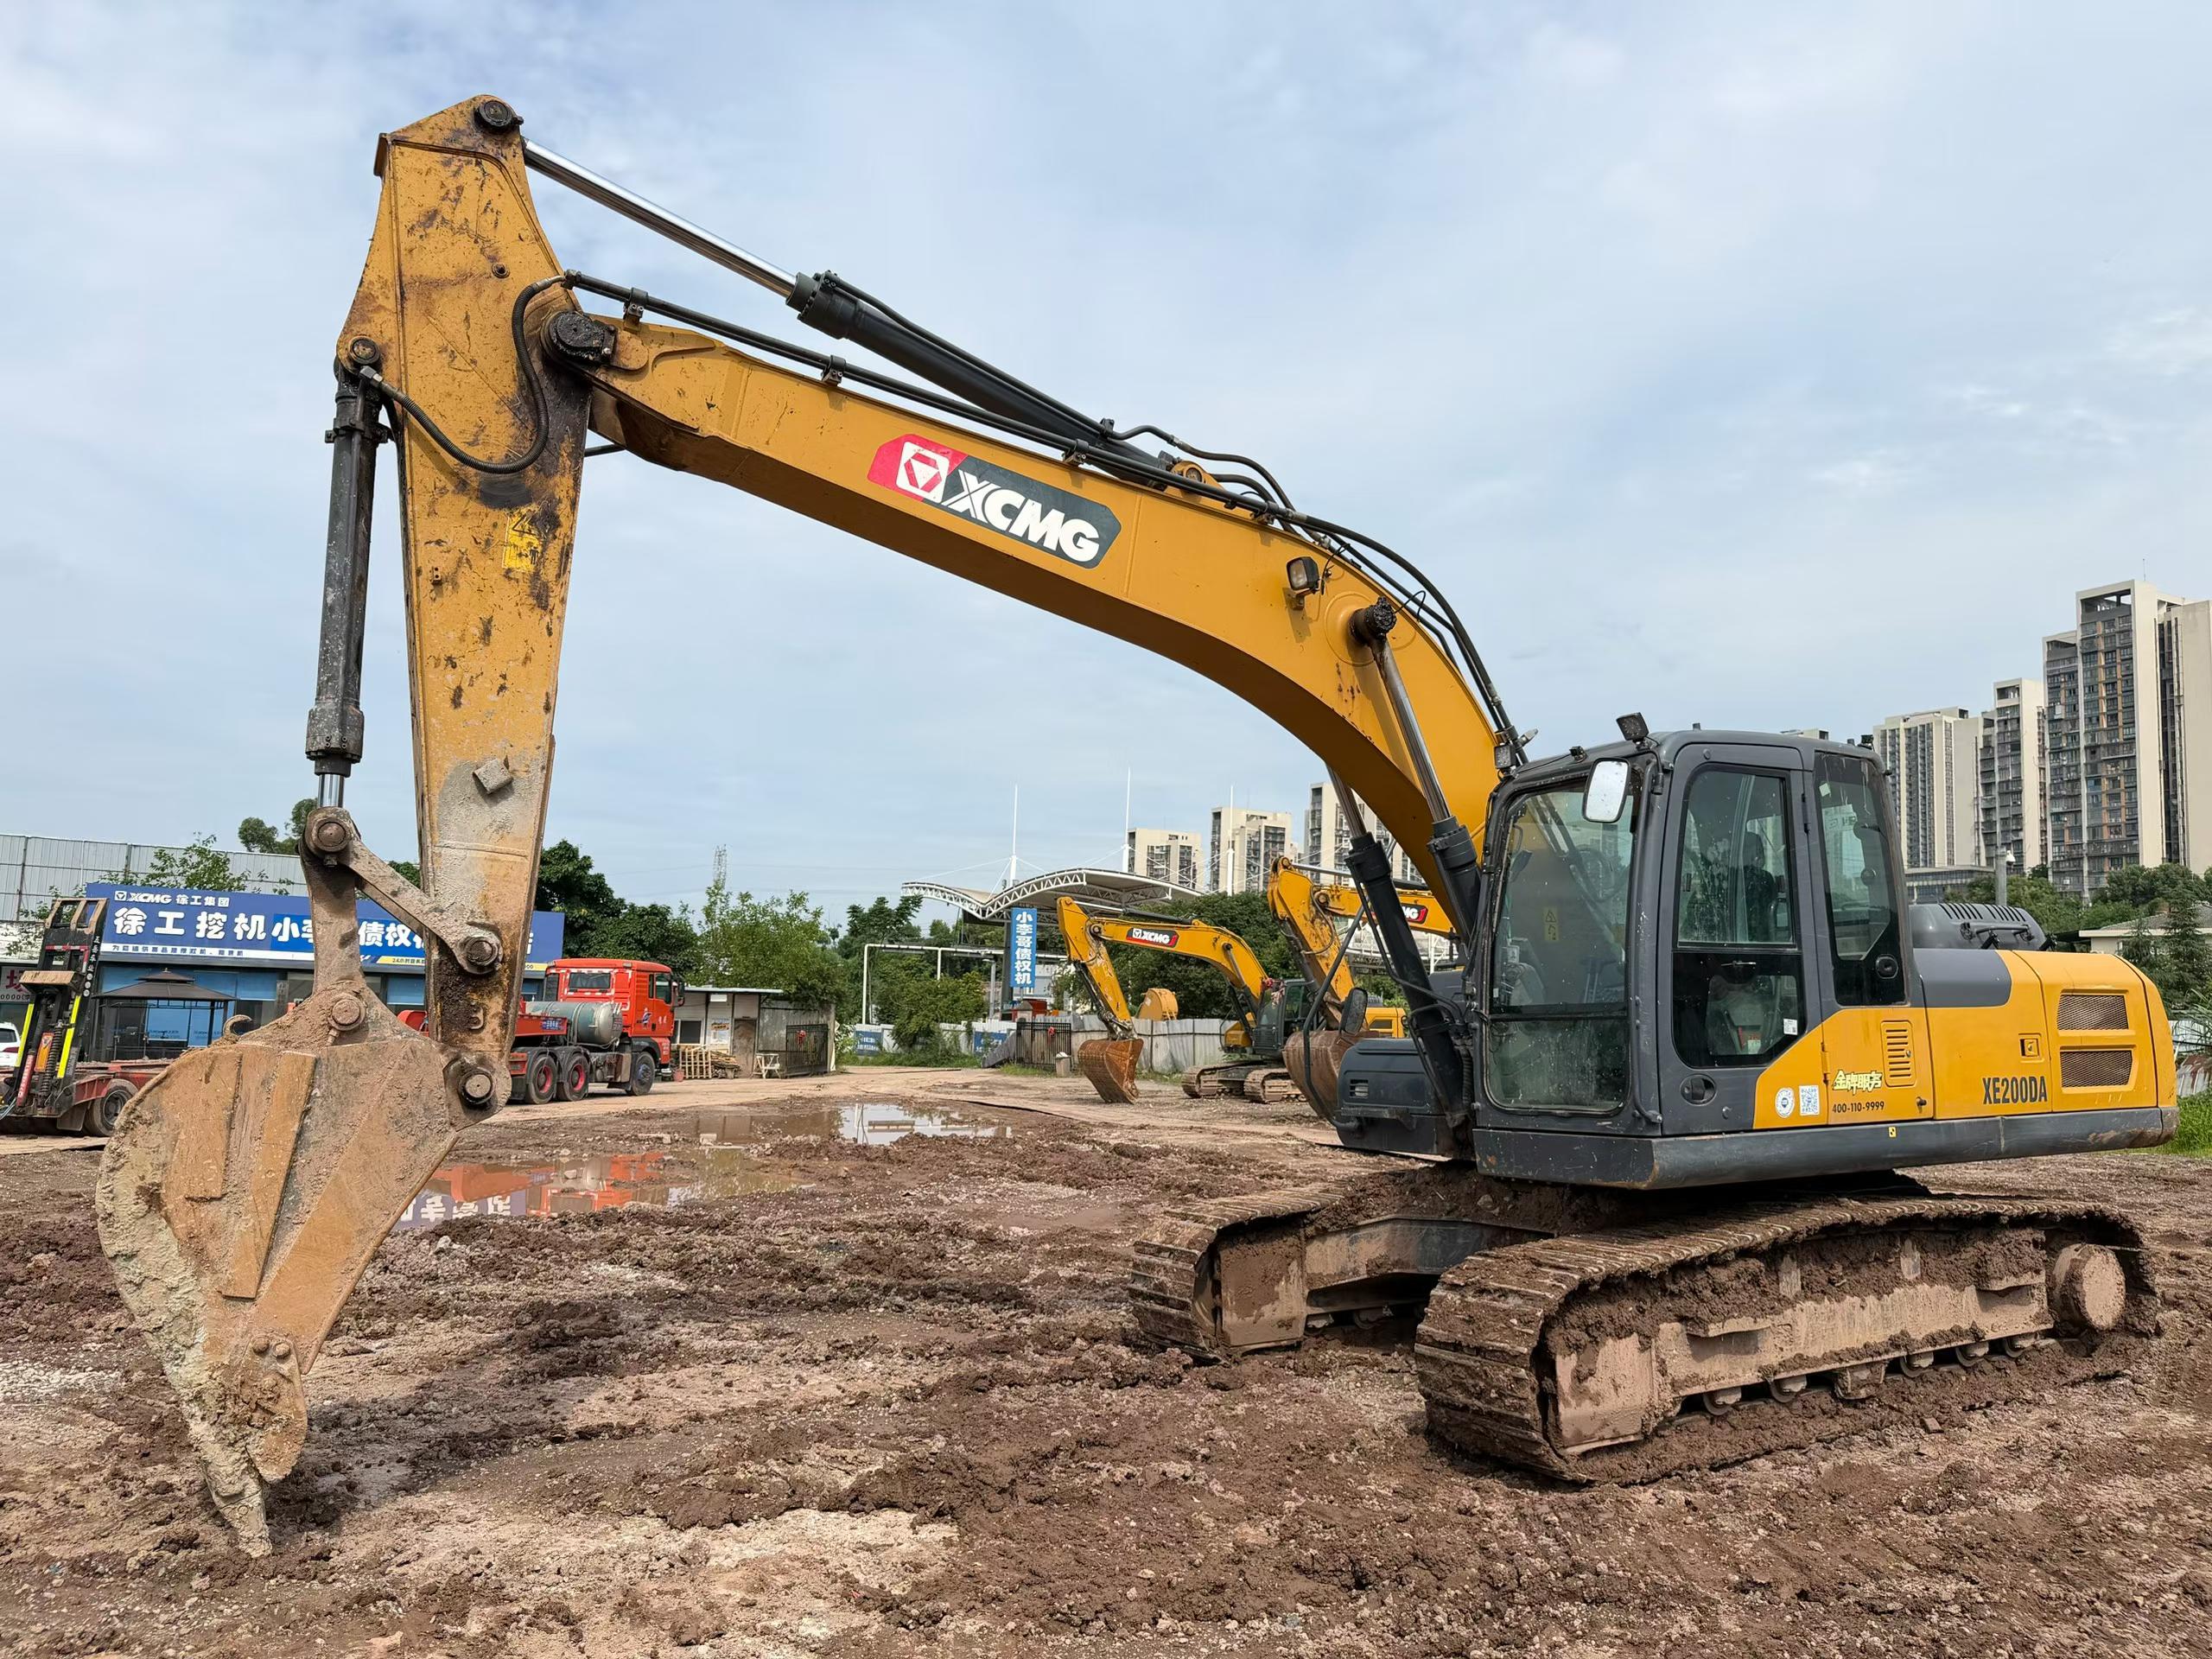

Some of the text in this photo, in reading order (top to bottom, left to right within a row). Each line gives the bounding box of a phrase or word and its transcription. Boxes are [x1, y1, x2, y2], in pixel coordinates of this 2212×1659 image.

[942, 469, 1100, 563] XCMG
[127, 893, 230, 907] XCMG 徐工集团
[113, 907, 267, 941] 徐工挖机
[1142, 931, 1171, 944] XCMG
[1014, 911, 1033, 984] 小李哥债权机
[1833, 1070, 1883, 1096] 金牌服务
[1982, 1076, 2048, 1105] XE200DA
[1833, 1101, 1885, 1114] 400-110-9999
